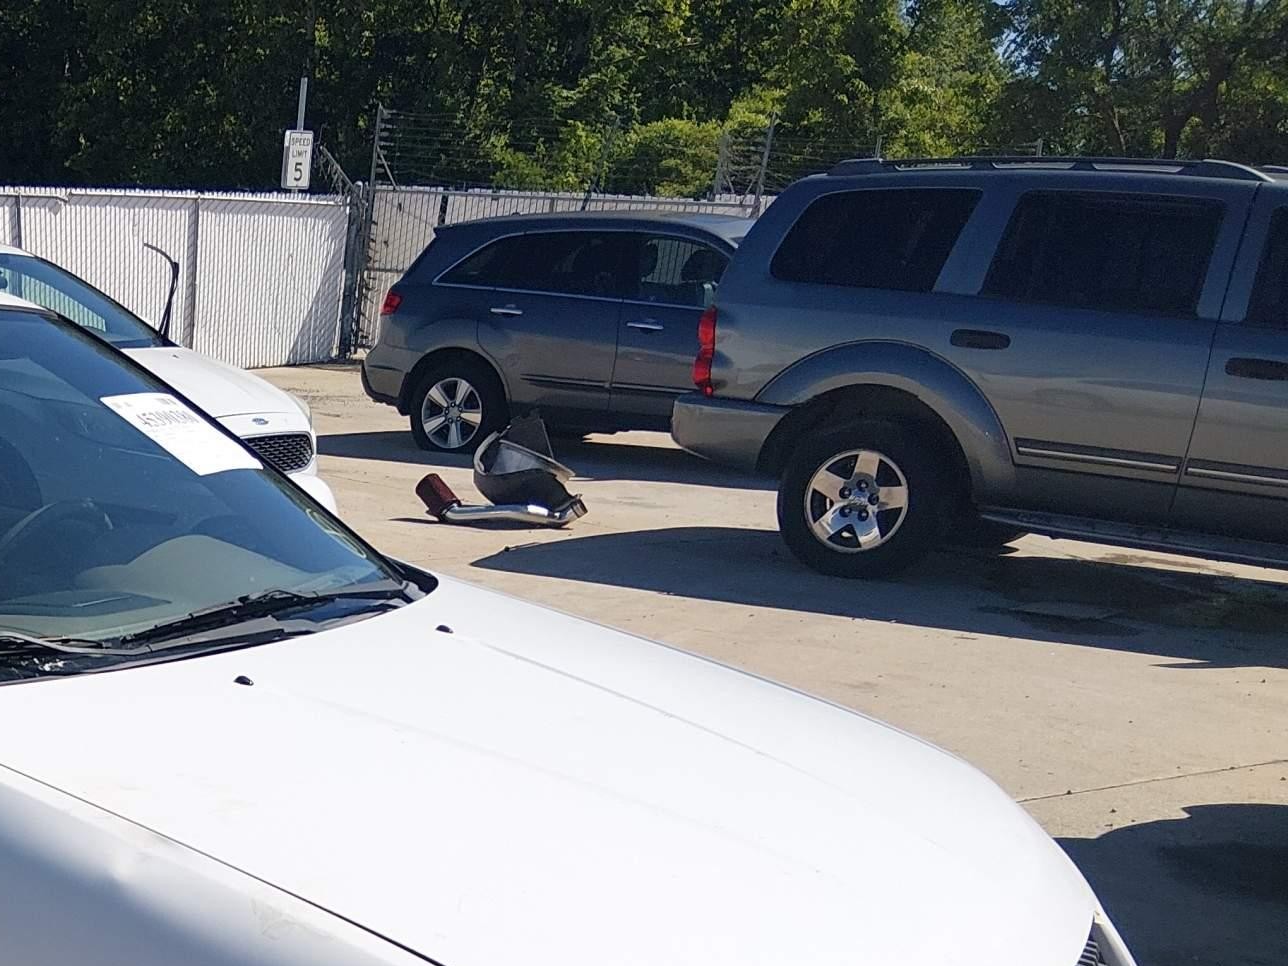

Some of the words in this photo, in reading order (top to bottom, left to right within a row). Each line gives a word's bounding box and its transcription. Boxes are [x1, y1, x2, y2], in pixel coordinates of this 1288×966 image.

[292, 137, 310, 146] SPEED
[292, 149, 308, 158] LIMIT
[293, 162, 303, 181] 5
